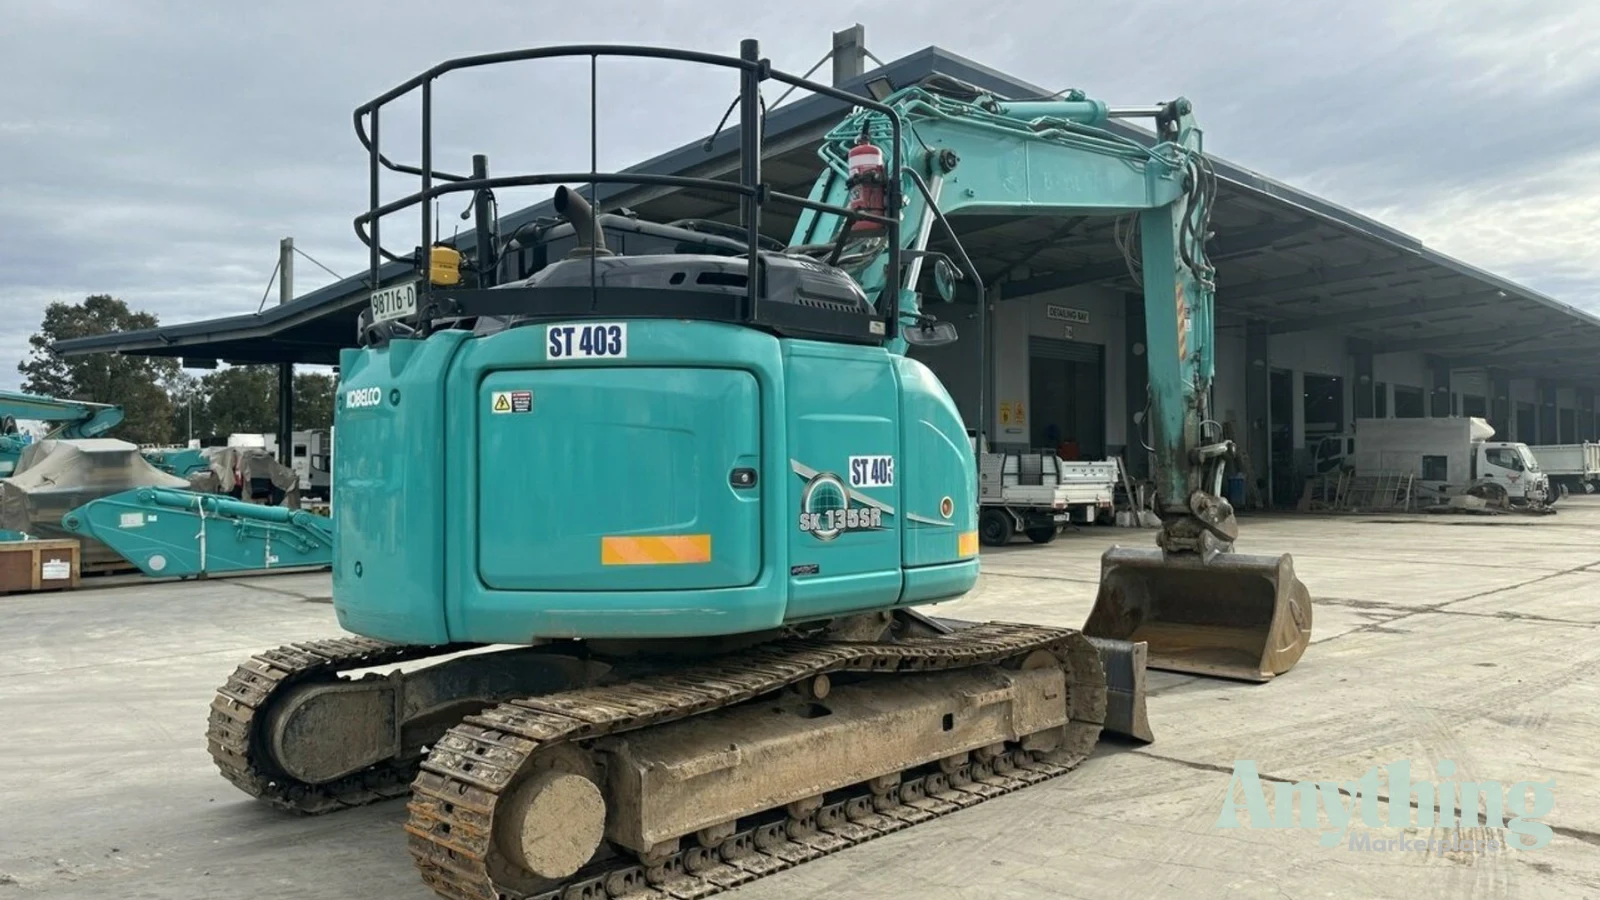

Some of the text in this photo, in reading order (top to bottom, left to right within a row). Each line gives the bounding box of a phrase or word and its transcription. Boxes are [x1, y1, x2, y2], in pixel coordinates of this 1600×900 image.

[549, 325, 622, 357] ST 403
[346, 386, 381, 408] KOBELCO
[852, 458, 869, 485] ST
[800, 507, 881, 531] SK 135SR
